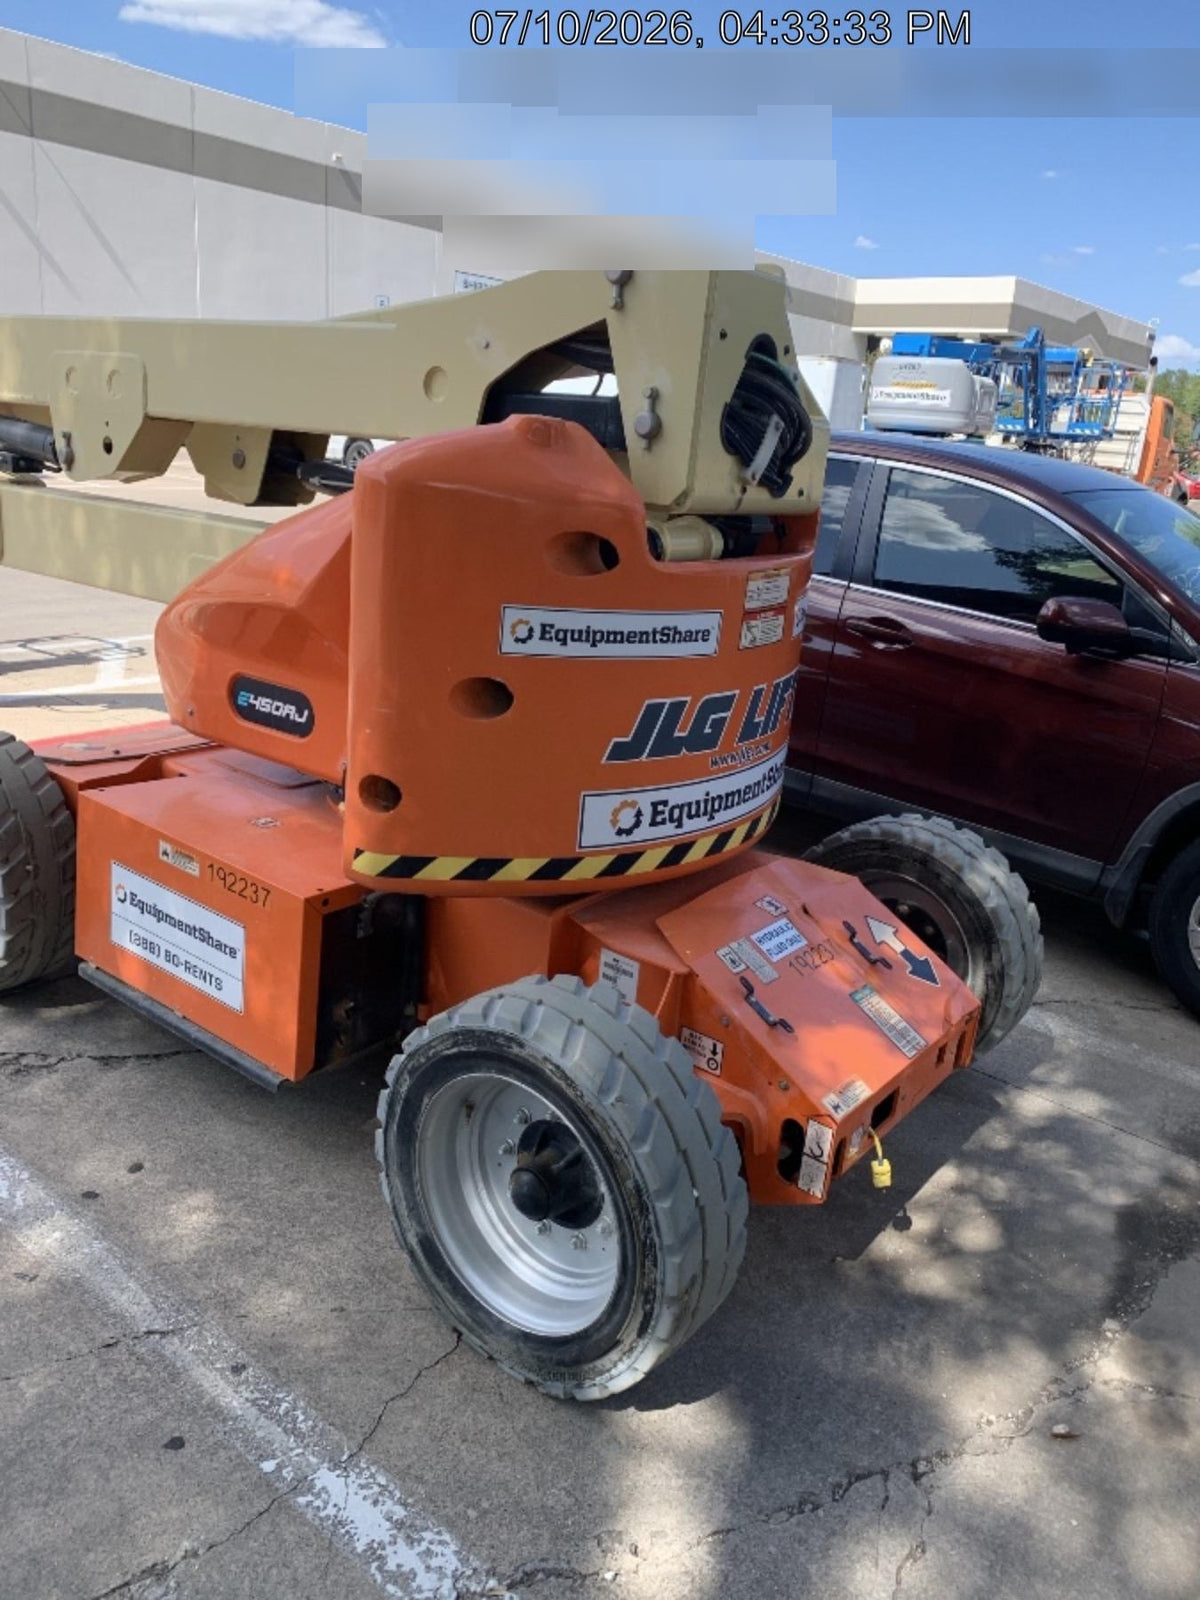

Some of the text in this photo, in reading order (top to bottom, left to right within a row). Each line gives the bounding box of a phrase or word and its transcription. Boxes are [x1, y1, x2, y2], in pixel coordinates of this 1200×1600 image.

[538, 622, 711, 647] EquipmentShare
[602, 690, 740, 764] JLG
[207, 862, 271, 908] 192237
[128, 891, 238, 960] EquipmentShare
